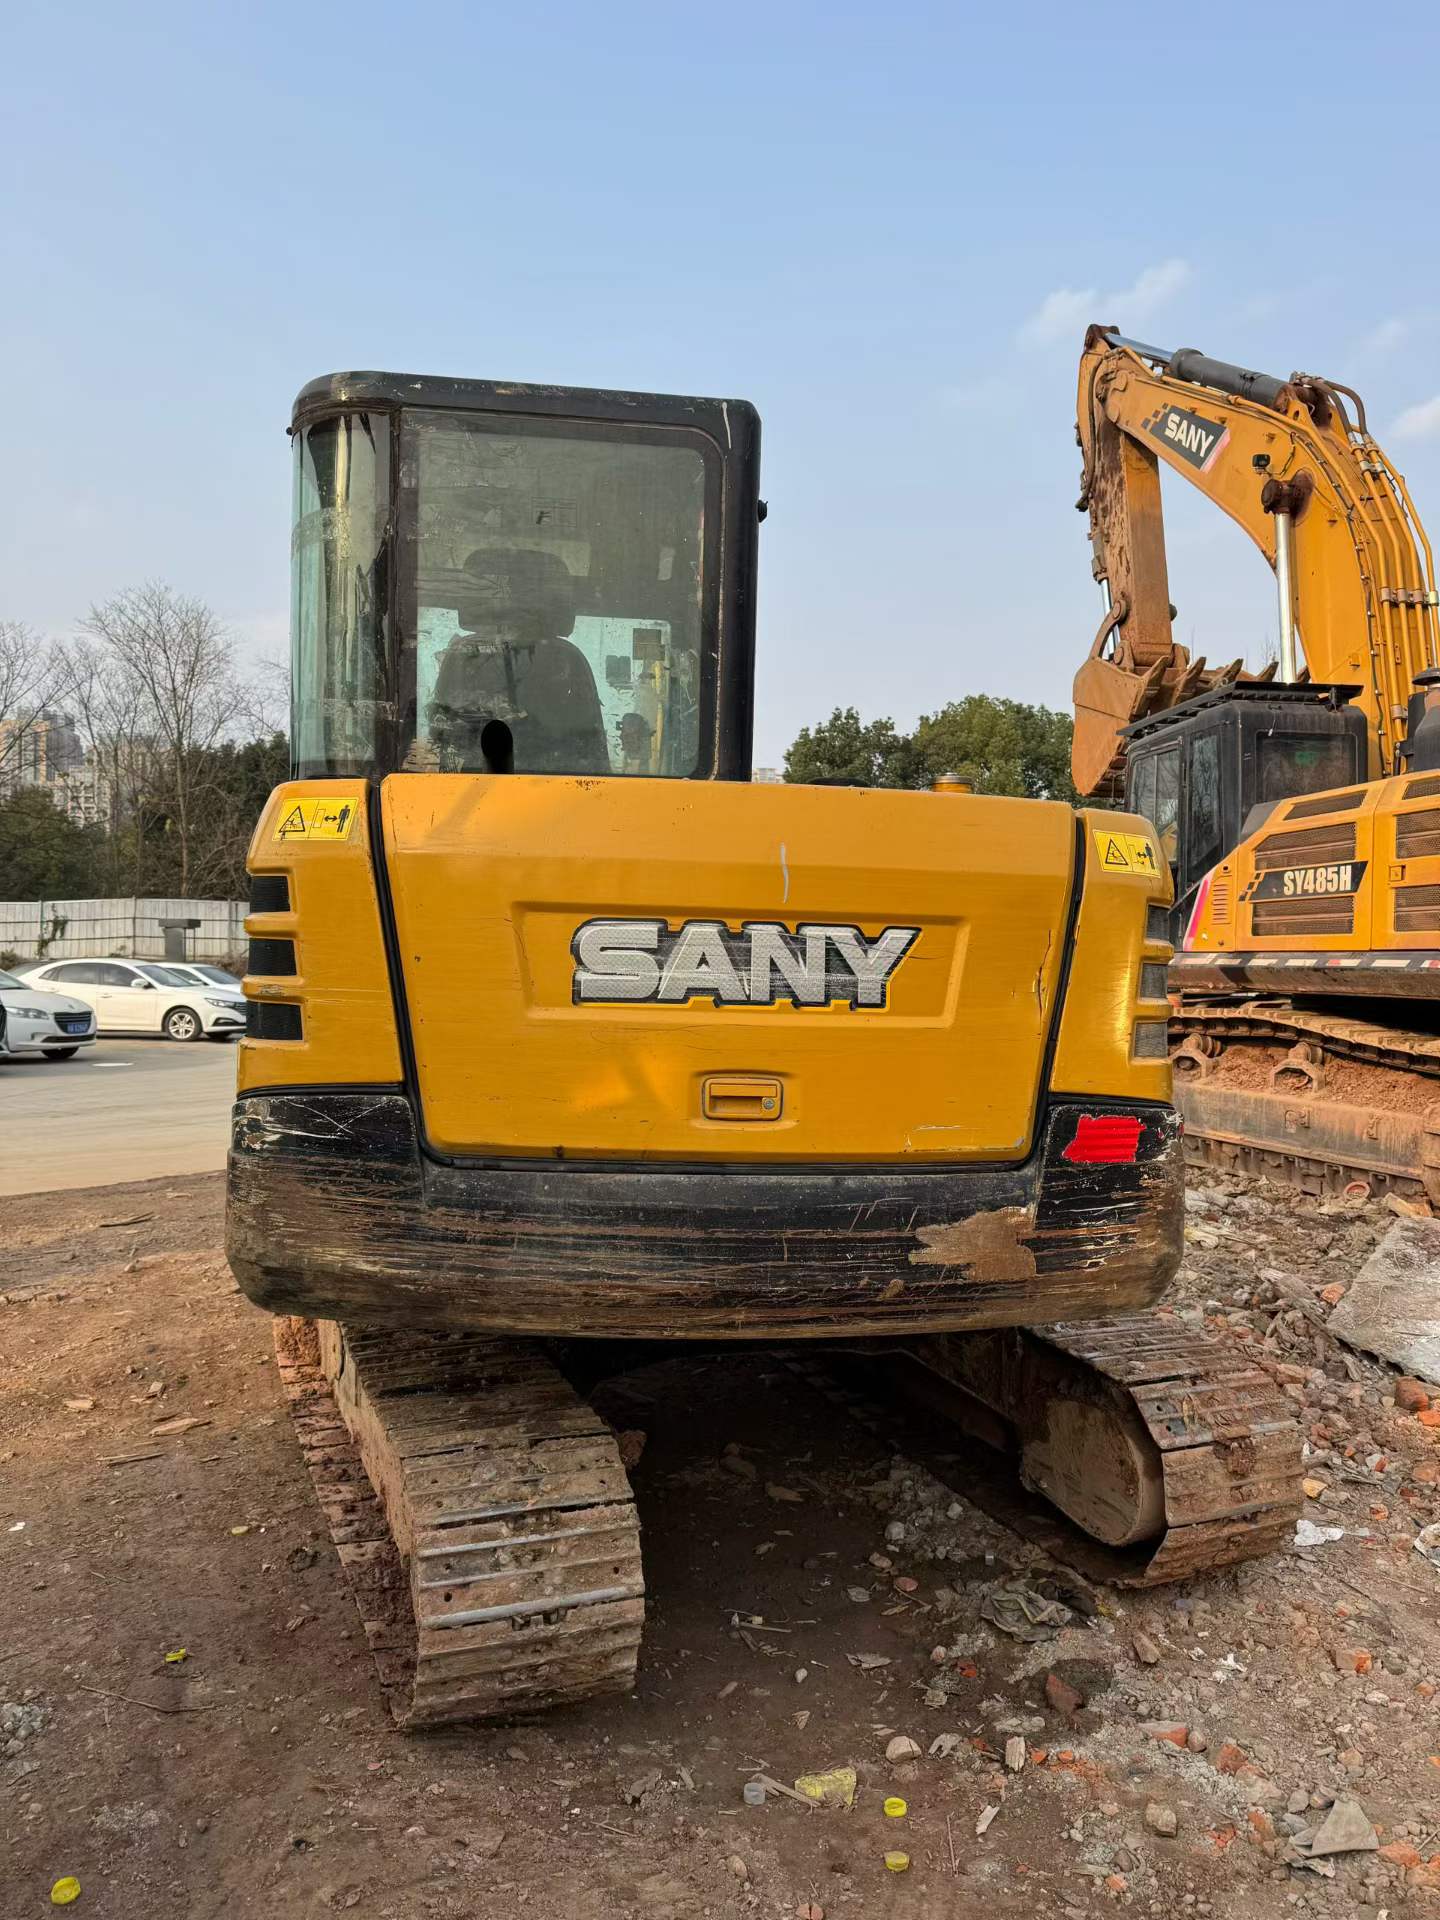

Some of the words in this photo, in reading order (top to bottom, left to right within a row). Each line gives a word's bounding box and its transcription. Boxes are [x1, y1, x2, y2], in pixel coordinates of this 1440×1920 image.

[1164, 413, 1214, 458] SANY
[1283, 864, 1352, 896] SY485H
[572, 918, 921, 1009] SANY
